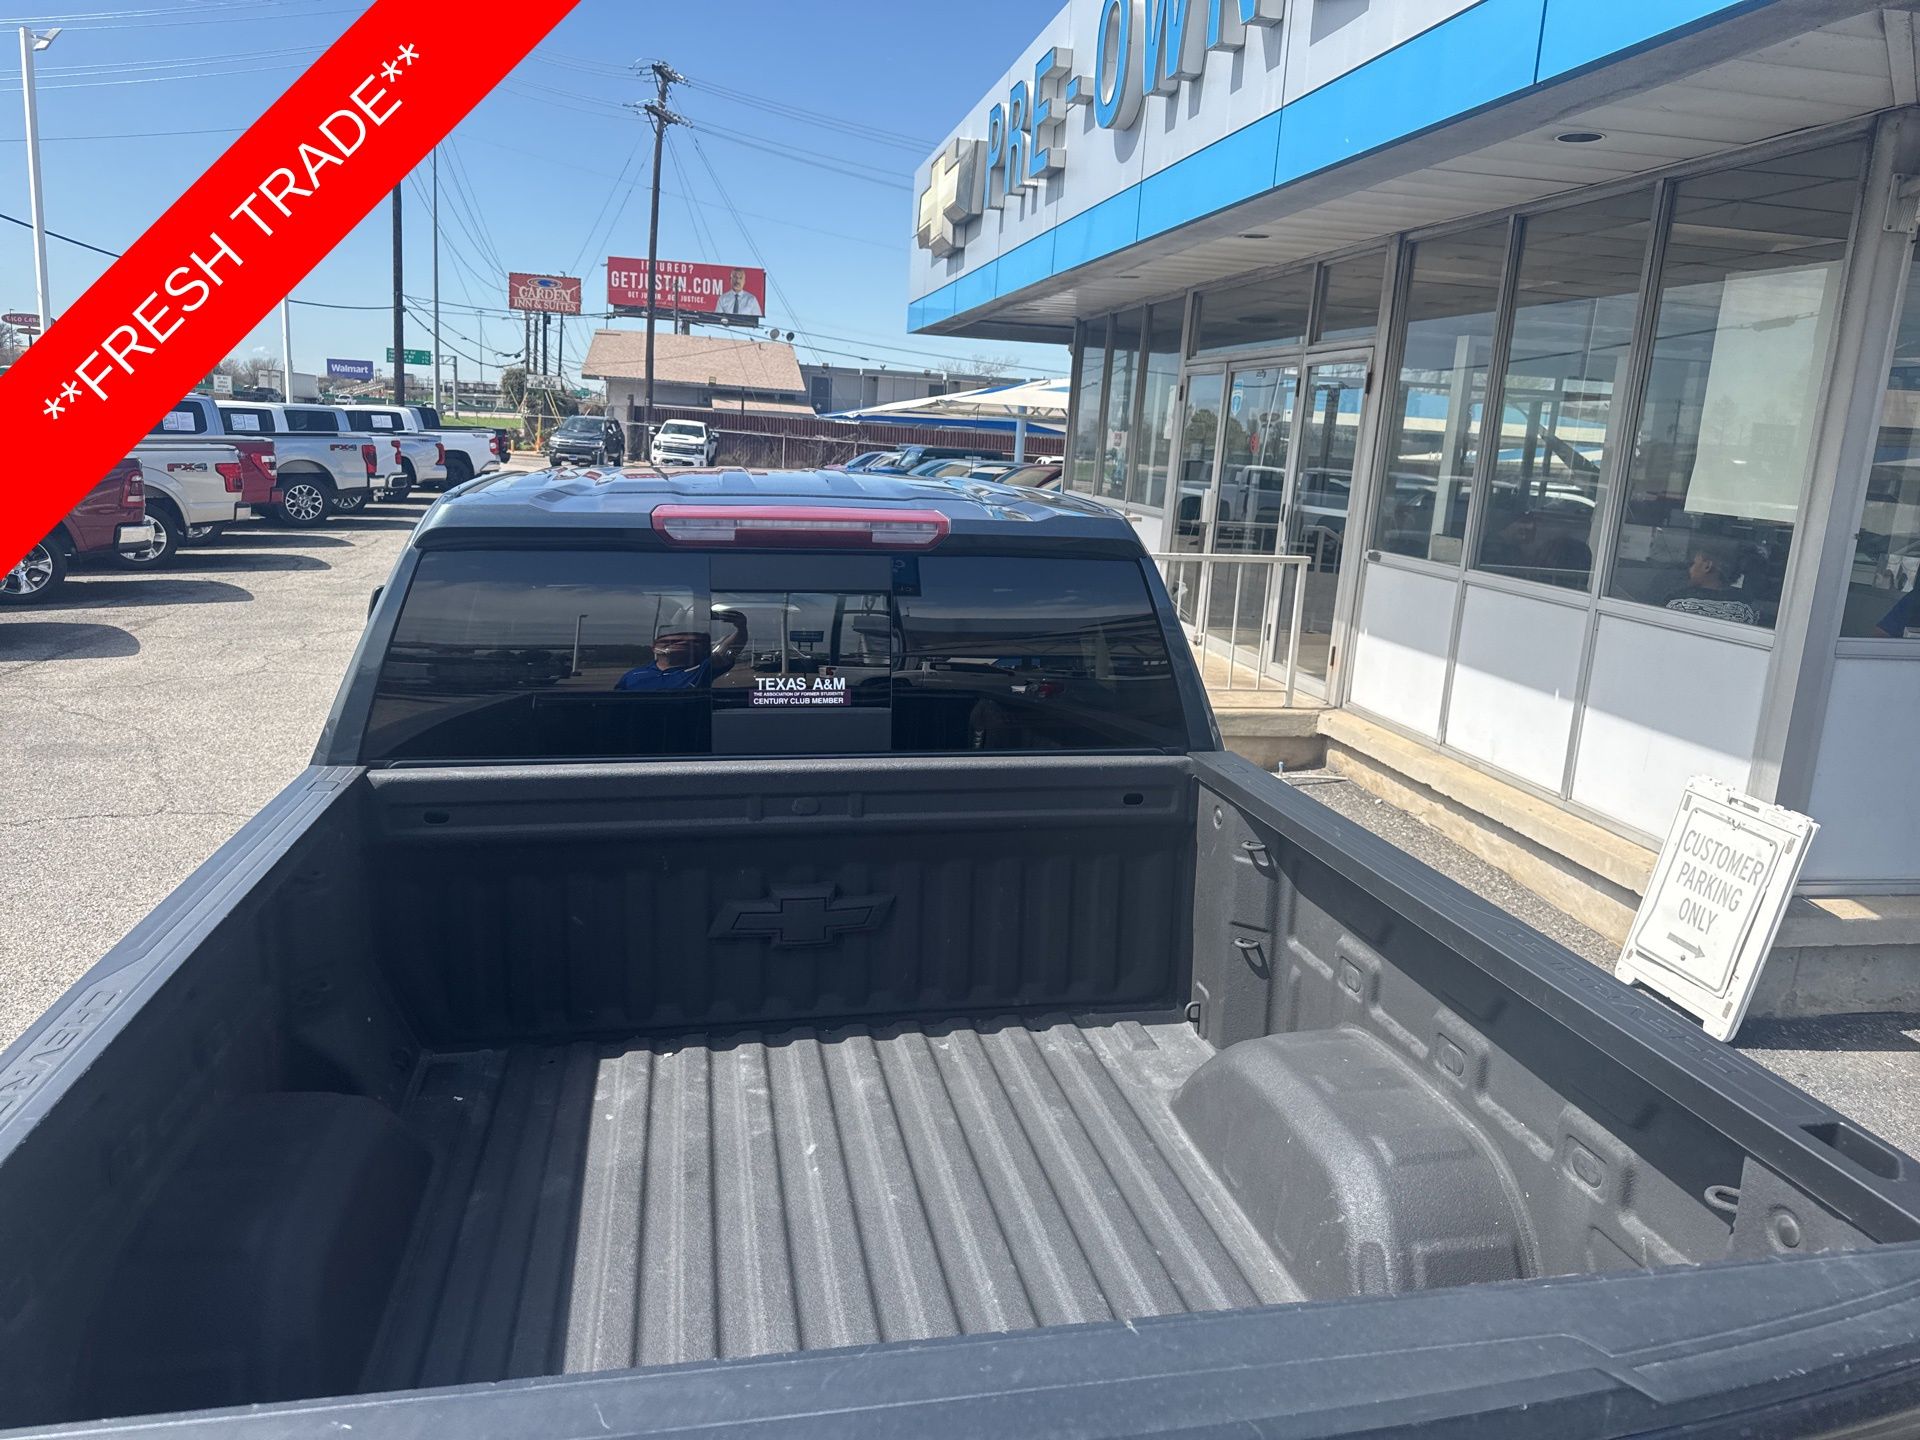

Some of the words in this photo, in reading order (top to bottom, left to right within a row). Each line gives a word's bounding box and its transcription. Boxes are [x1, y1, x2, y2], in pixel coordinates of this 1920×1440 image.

[611, 270, 723, 296] GETJUSTIN.COM
[518, 285, 570, 302] GARDEN
[513, 298, 533, 308] INN
[533, 299, 542, 309] &
[543, 301, 576, 312] SUITES
[331, 363, 369, 374] Walmart
[167, 463, 208, 472] FX4
[755, 677, 806, 690] TEXAS
[812, 677, 846, 690] A&M
[753, 697, 789, 705] CENTURY
[789, 697, 811, 705] CLUB
[1683, 829, 1764, 886] CUSTOMER
[1676, 861, 1743, 912] PARKING
[1678, 897, 1718, 935] ONLY
